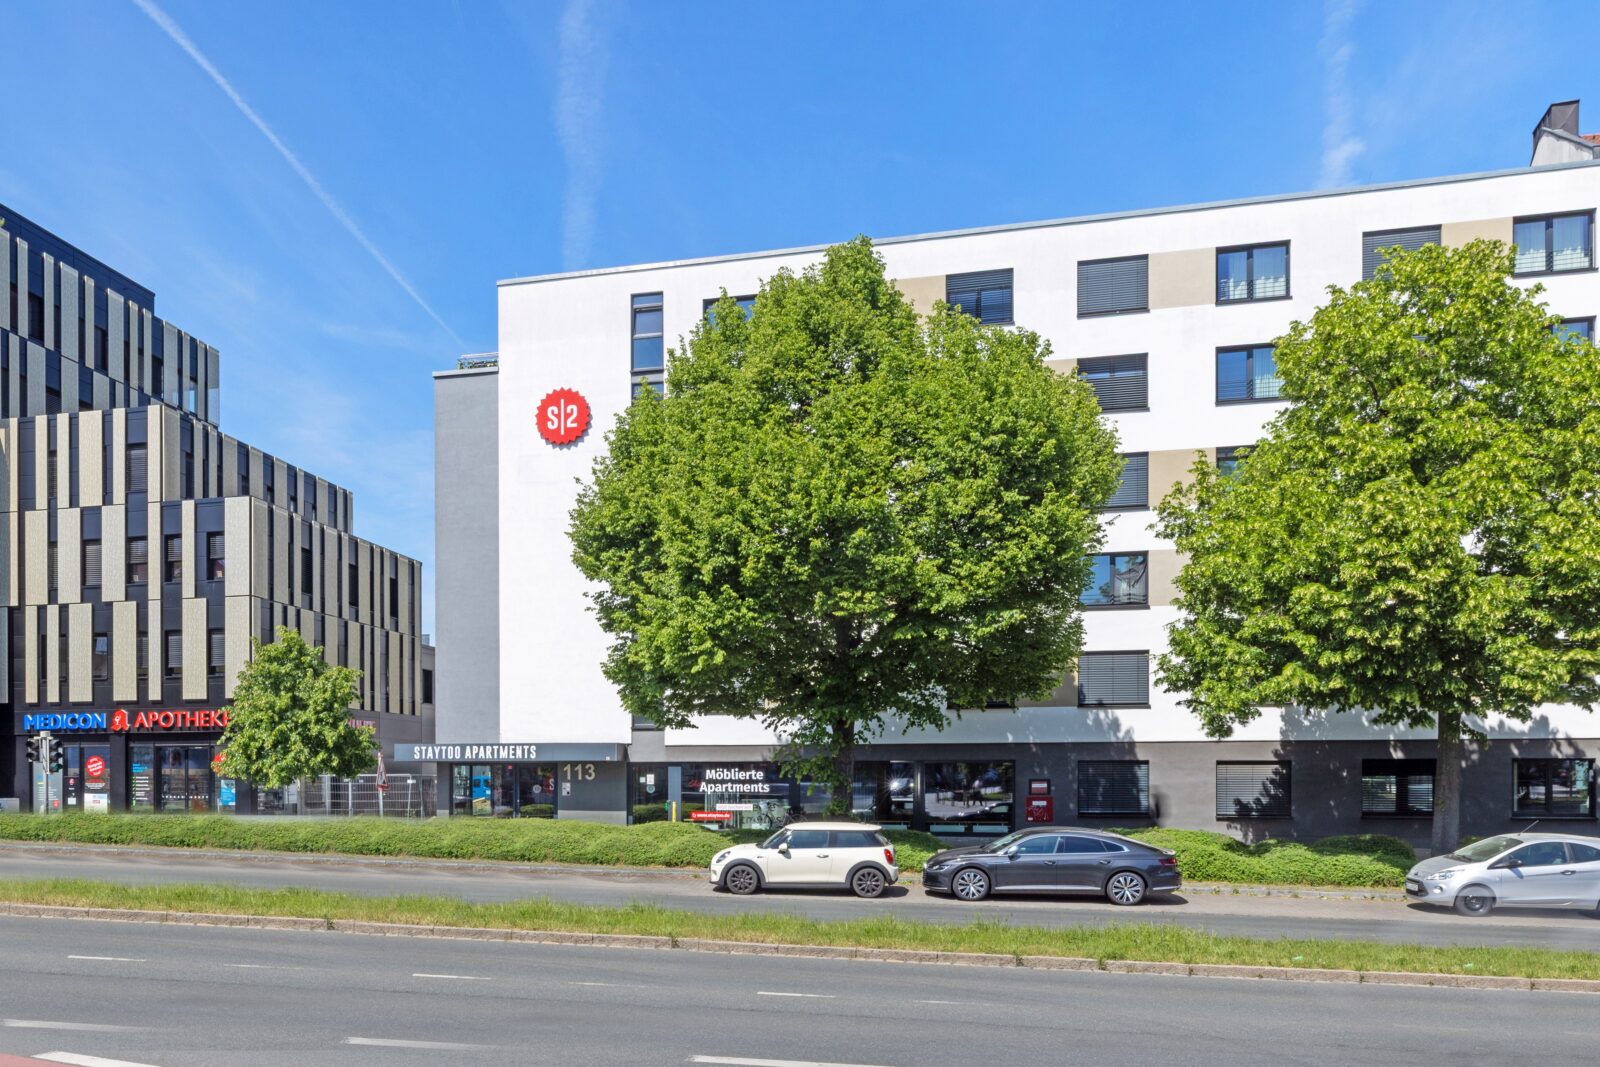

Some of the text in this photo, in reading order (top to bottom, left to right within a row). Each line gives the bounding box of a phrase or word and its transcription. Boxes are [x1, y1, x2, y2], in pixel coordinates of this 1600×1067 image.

[24, 713, 106, 731] MEDICON
[414, 745, 537, 760] STAYTOO APARTMENTS
[563, 763, 596, 781] 113
[705, 768, 764, 780] Möblierte
[700, 781, 770, 795] Apartments
